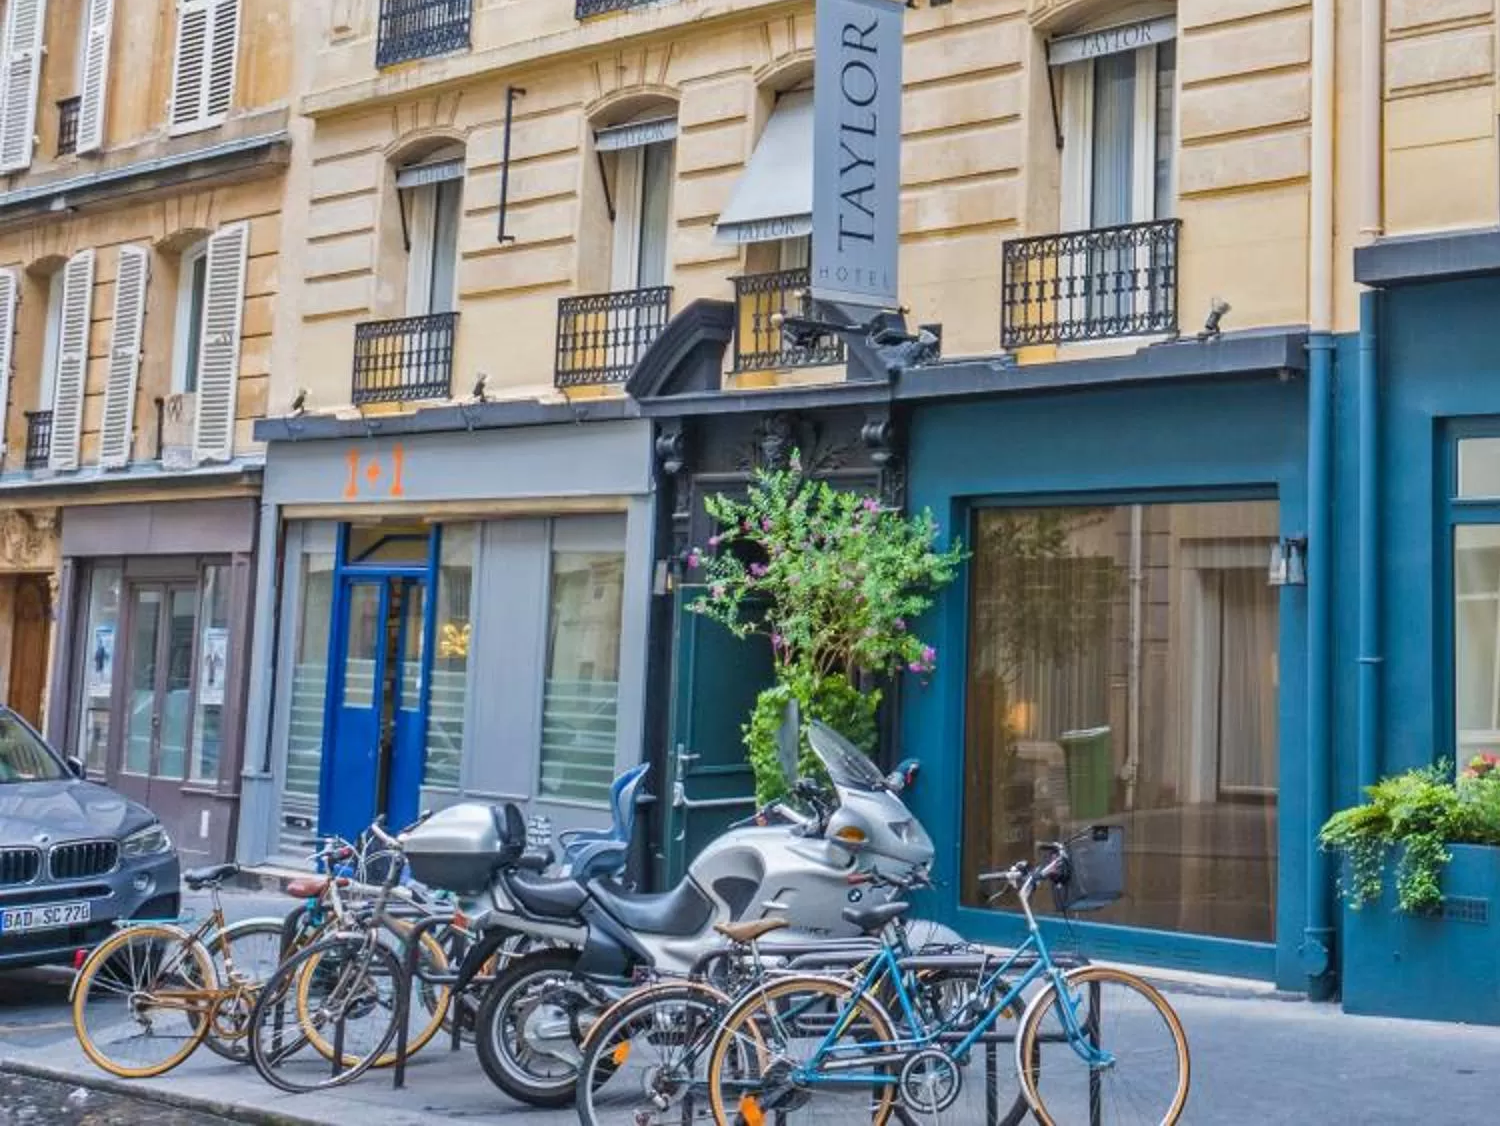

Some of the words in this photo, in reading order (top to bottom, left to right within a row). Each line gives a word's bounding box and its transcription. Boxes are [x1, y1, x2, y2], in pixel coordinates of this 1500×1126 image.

[1080, 25, 1152, 56] TAYLOR
[838, 17, 880, 254] TAYLOR
[737, 217, 796, 241] TAYLOR
